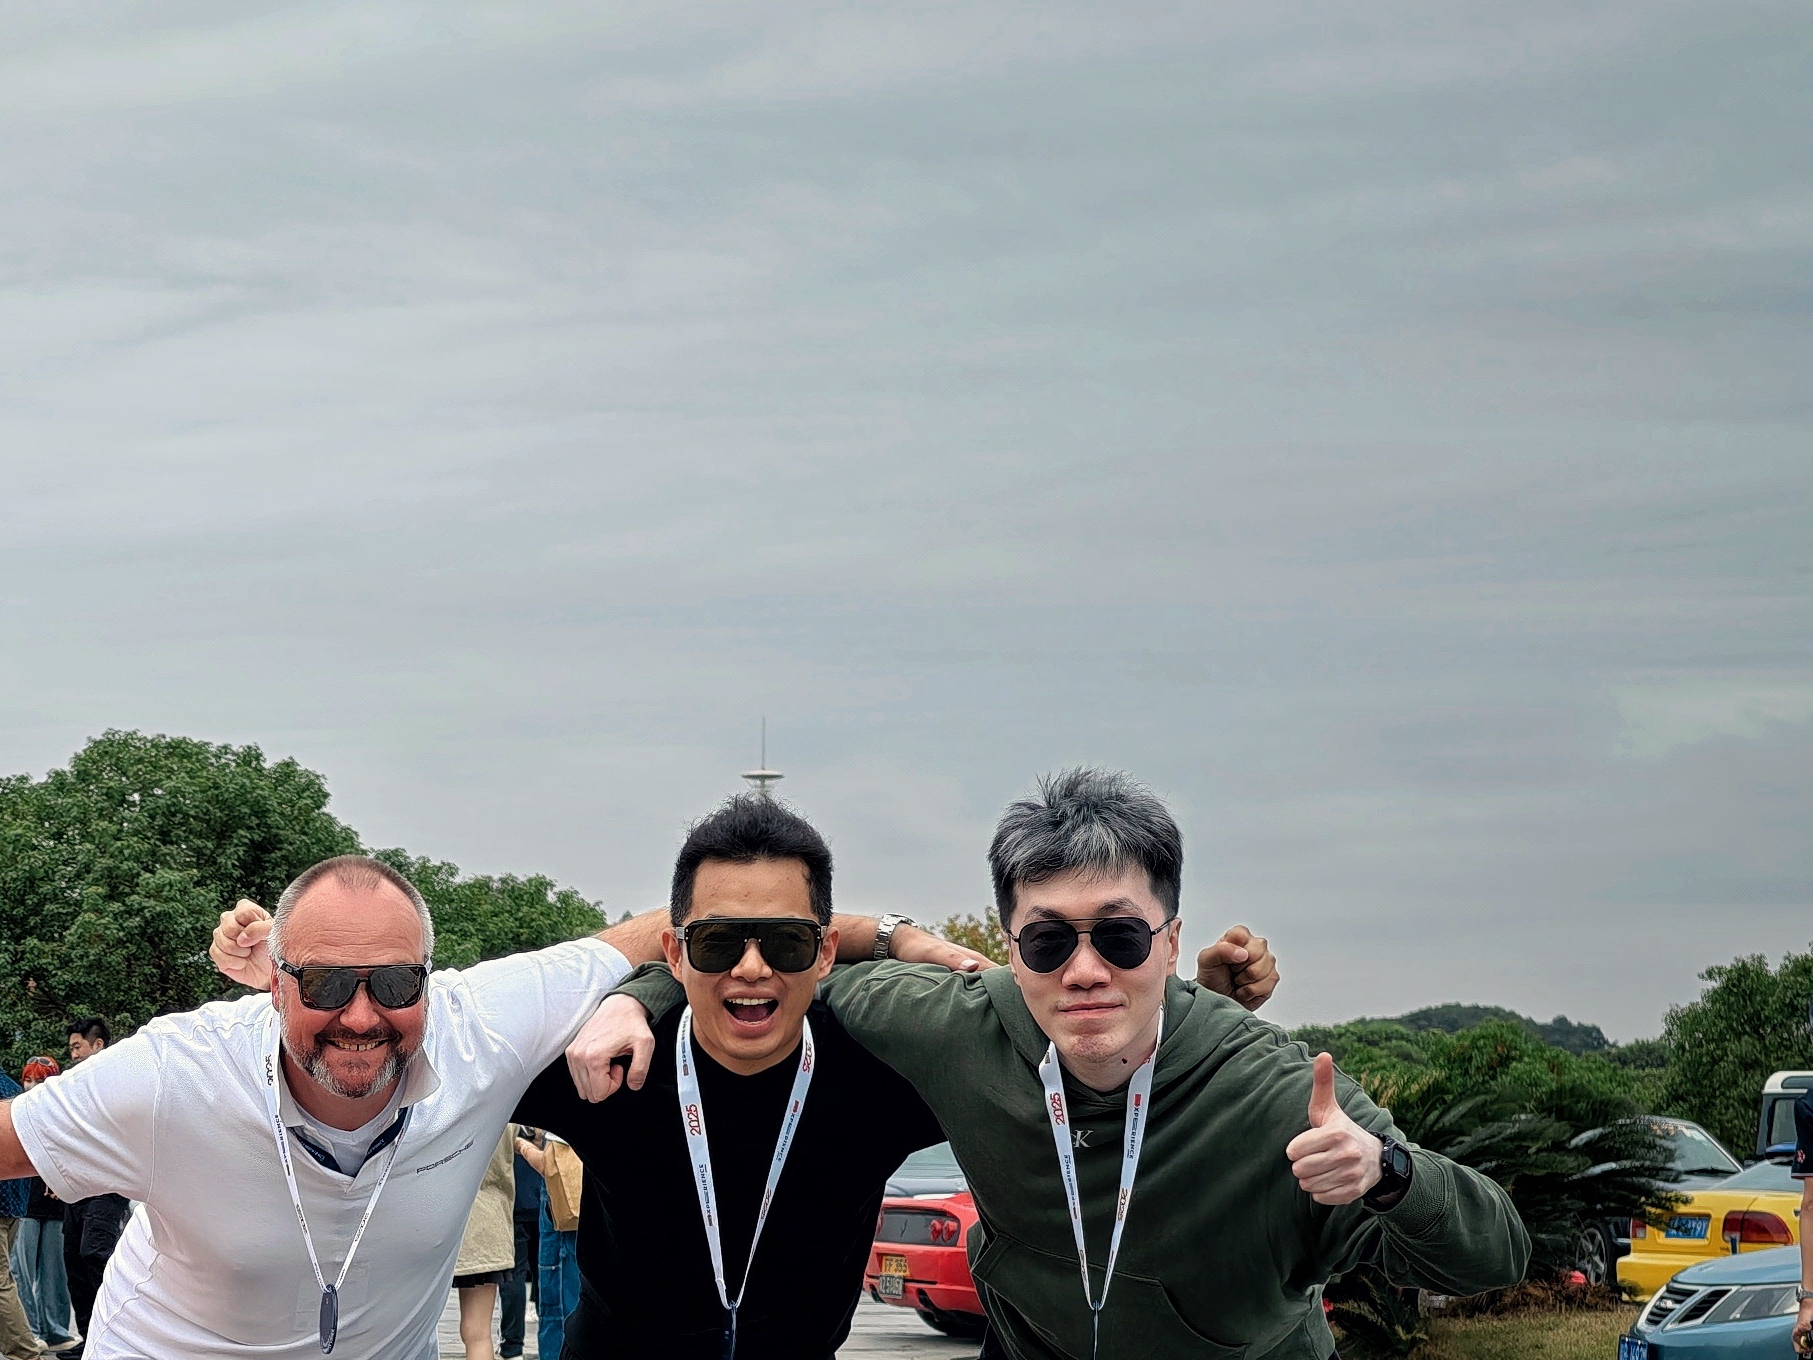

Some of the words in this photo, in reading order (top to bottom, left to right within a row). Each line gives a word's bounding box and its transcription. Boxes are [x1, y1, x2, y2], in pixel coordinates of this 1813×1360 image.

[685, 1104, 702, 1136] 2025
[1050, 1092, 1066, 1126] 2025
[416, 1140, 474, 1174] PORSCHE
